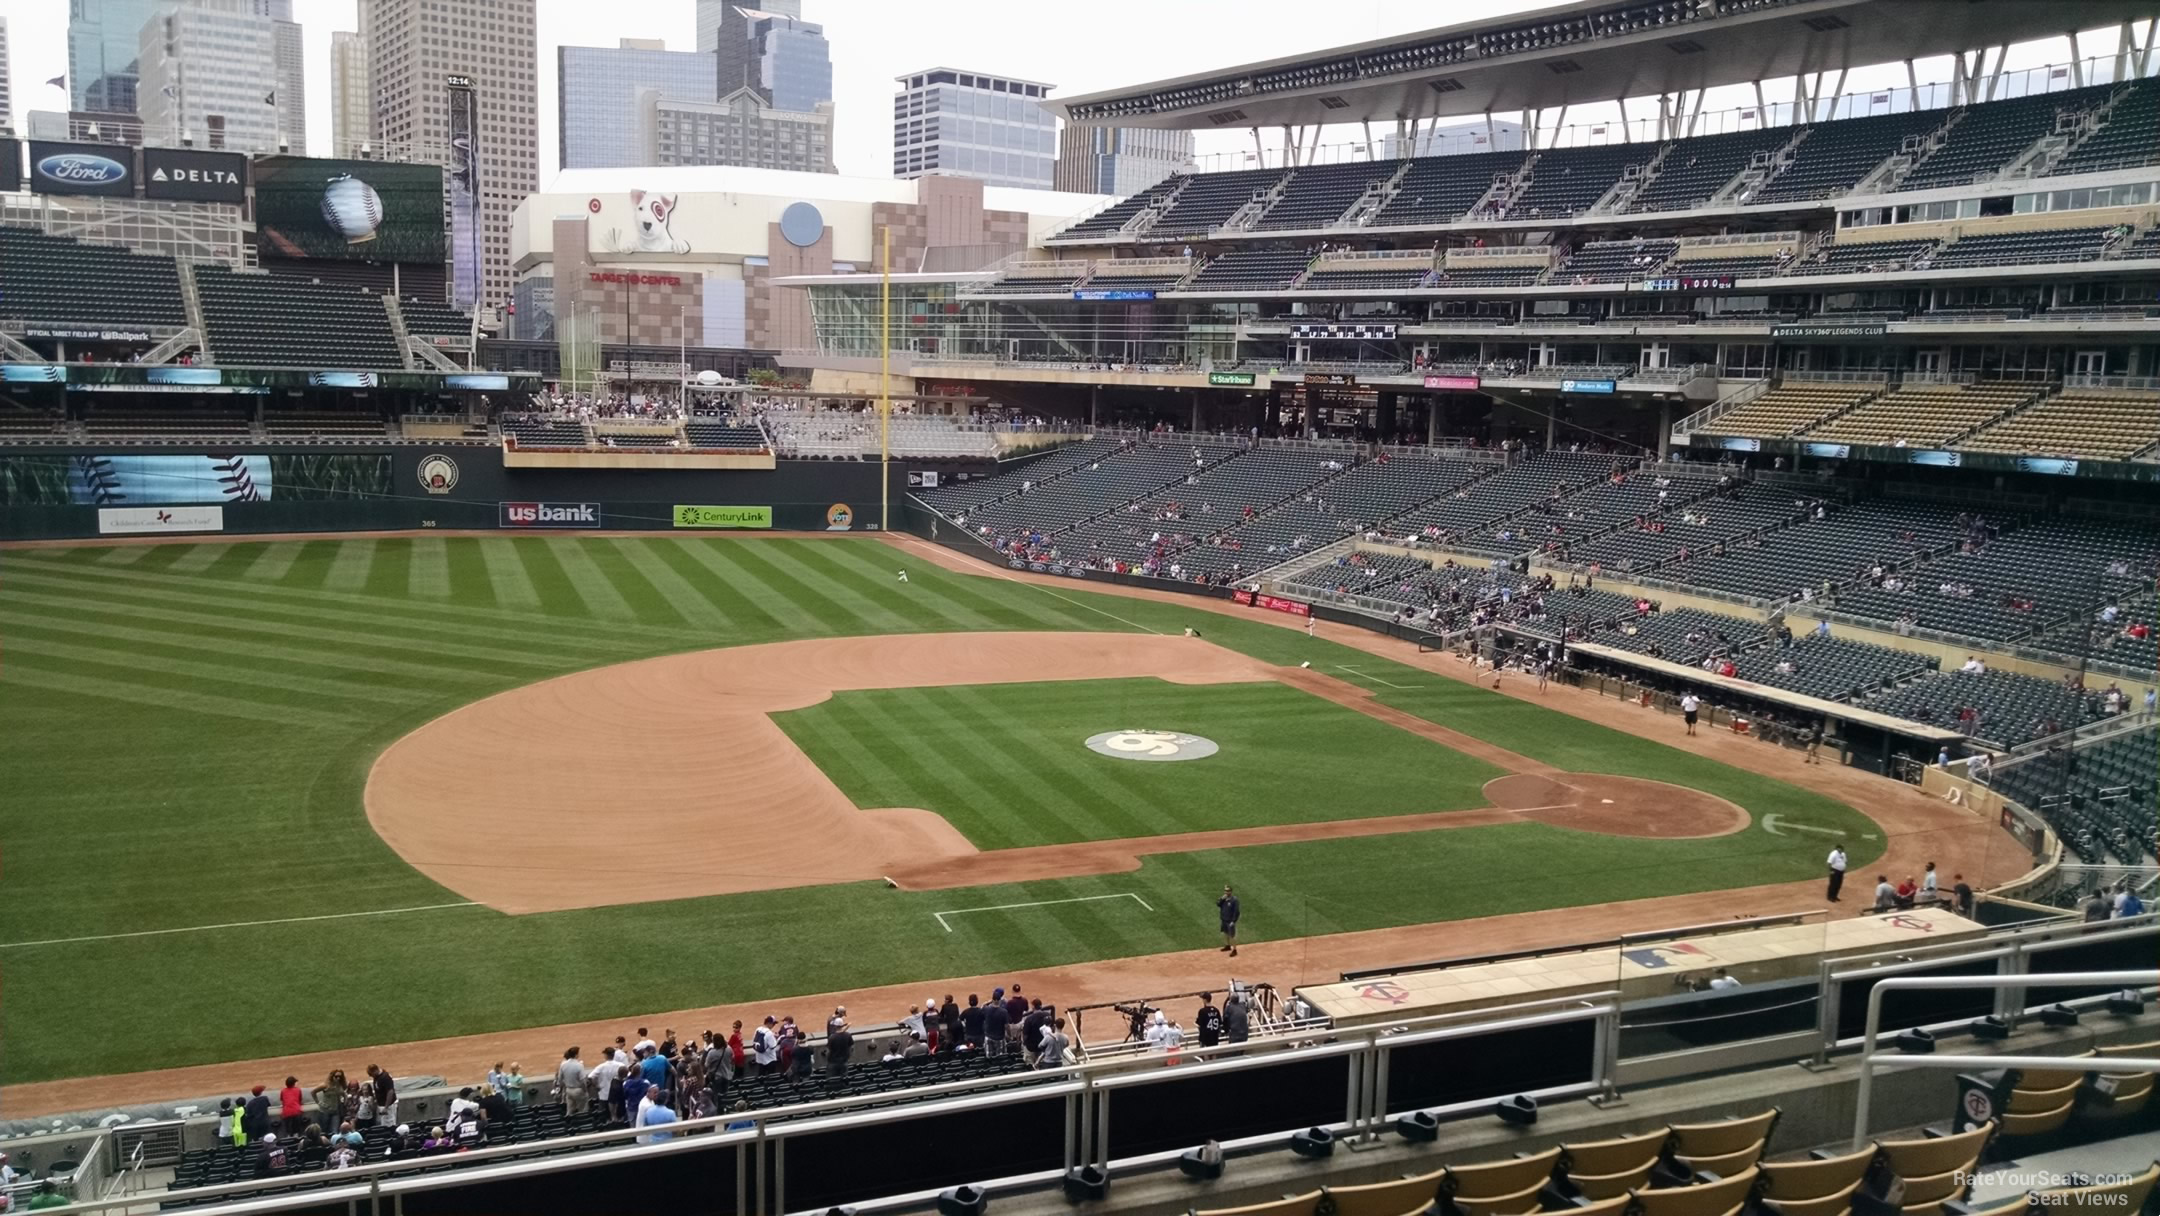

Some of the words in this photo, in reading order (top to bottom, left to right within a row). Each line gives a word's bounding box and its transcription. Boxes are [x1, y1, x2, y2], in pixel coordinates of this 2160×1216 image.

[448, 76, 469, 85] 12:14
[55, 157, 108, 181] Ford
[173, 168, 239, 184] DELTA
[589, 272, 629, 284] TARGET
[641, 275, 681, 286] CENTER
[72, 330, 88, 338] FIELD
[111, 331, 149, 342] Ballpark
[1780, 328, 1803, 336] DELTA
[1832, 327, 1863, 335] LEGENDS
[1865, 327, 1884, 335] CLUB
[703, 511, 763, 523] CenturyLink
[1206, 1018, 1219, 1030] 49
